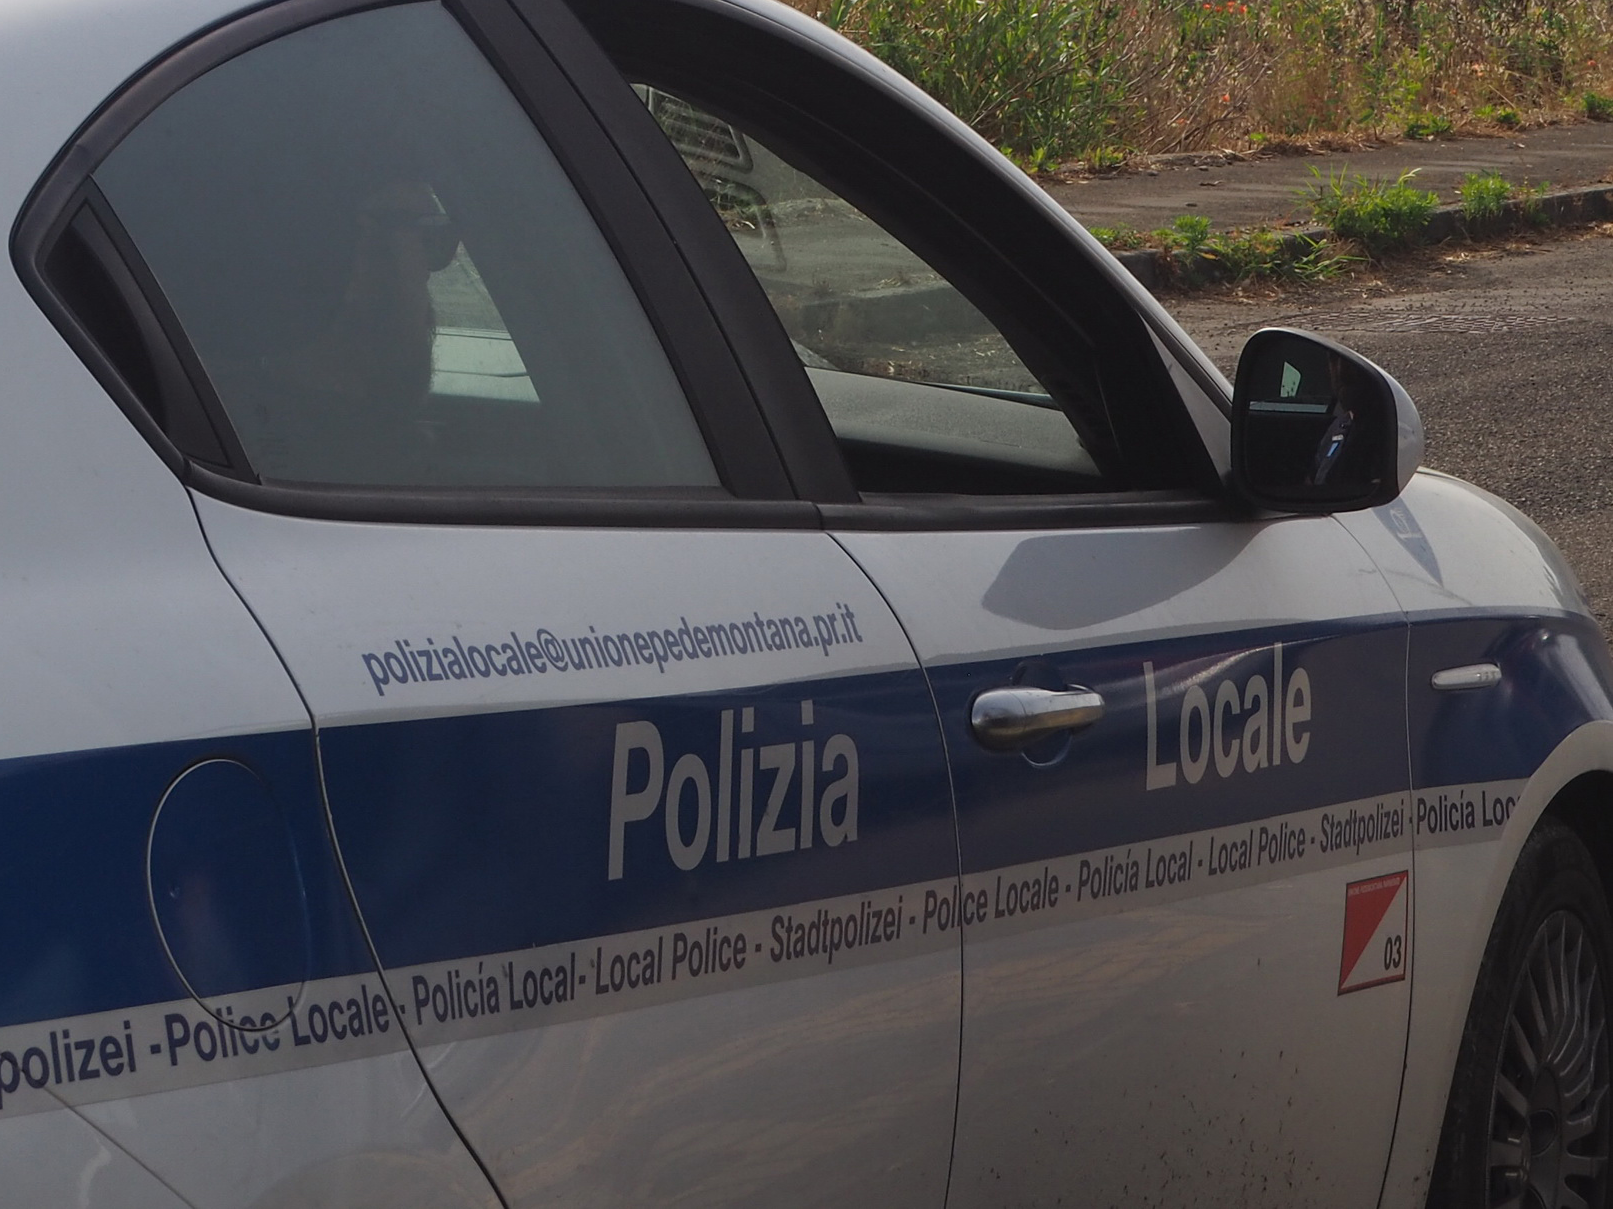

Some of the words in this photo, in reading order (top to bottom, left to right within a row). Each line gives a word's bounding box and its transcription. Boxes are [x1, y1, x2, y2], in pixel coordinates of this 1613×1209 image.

[361, 602, 864, 696] polizialocale@unionepedemontana.pr.it
[1142, 642, 1313, 791] Locale
[607, 699, 860, 882] Polizia
[287, 985, 389, 1047] Locale
[411, 961, 500, 1026] Policía
[594, 935, 664, 995] Local
[671, 926, 747, 981] Police
[770, 894, 903, 965] Stadtpolizei
[922, 884, 988, 935] Police
[994, 867, 1059, 919] Locale
[1077, 849, 1139, 902] Policía
[1145, 840, 1193, 889] Local
[1208, 829, 1254, 876] Local
[1257, 822, 1306, 866] Police
[1320, 799, 1404, 855] Stadtpolizei
[1416, 789, 1476, 835] Policía
[1482, 790, 1521, 827] Loc
[1384, 935, 1402, 971] 03
